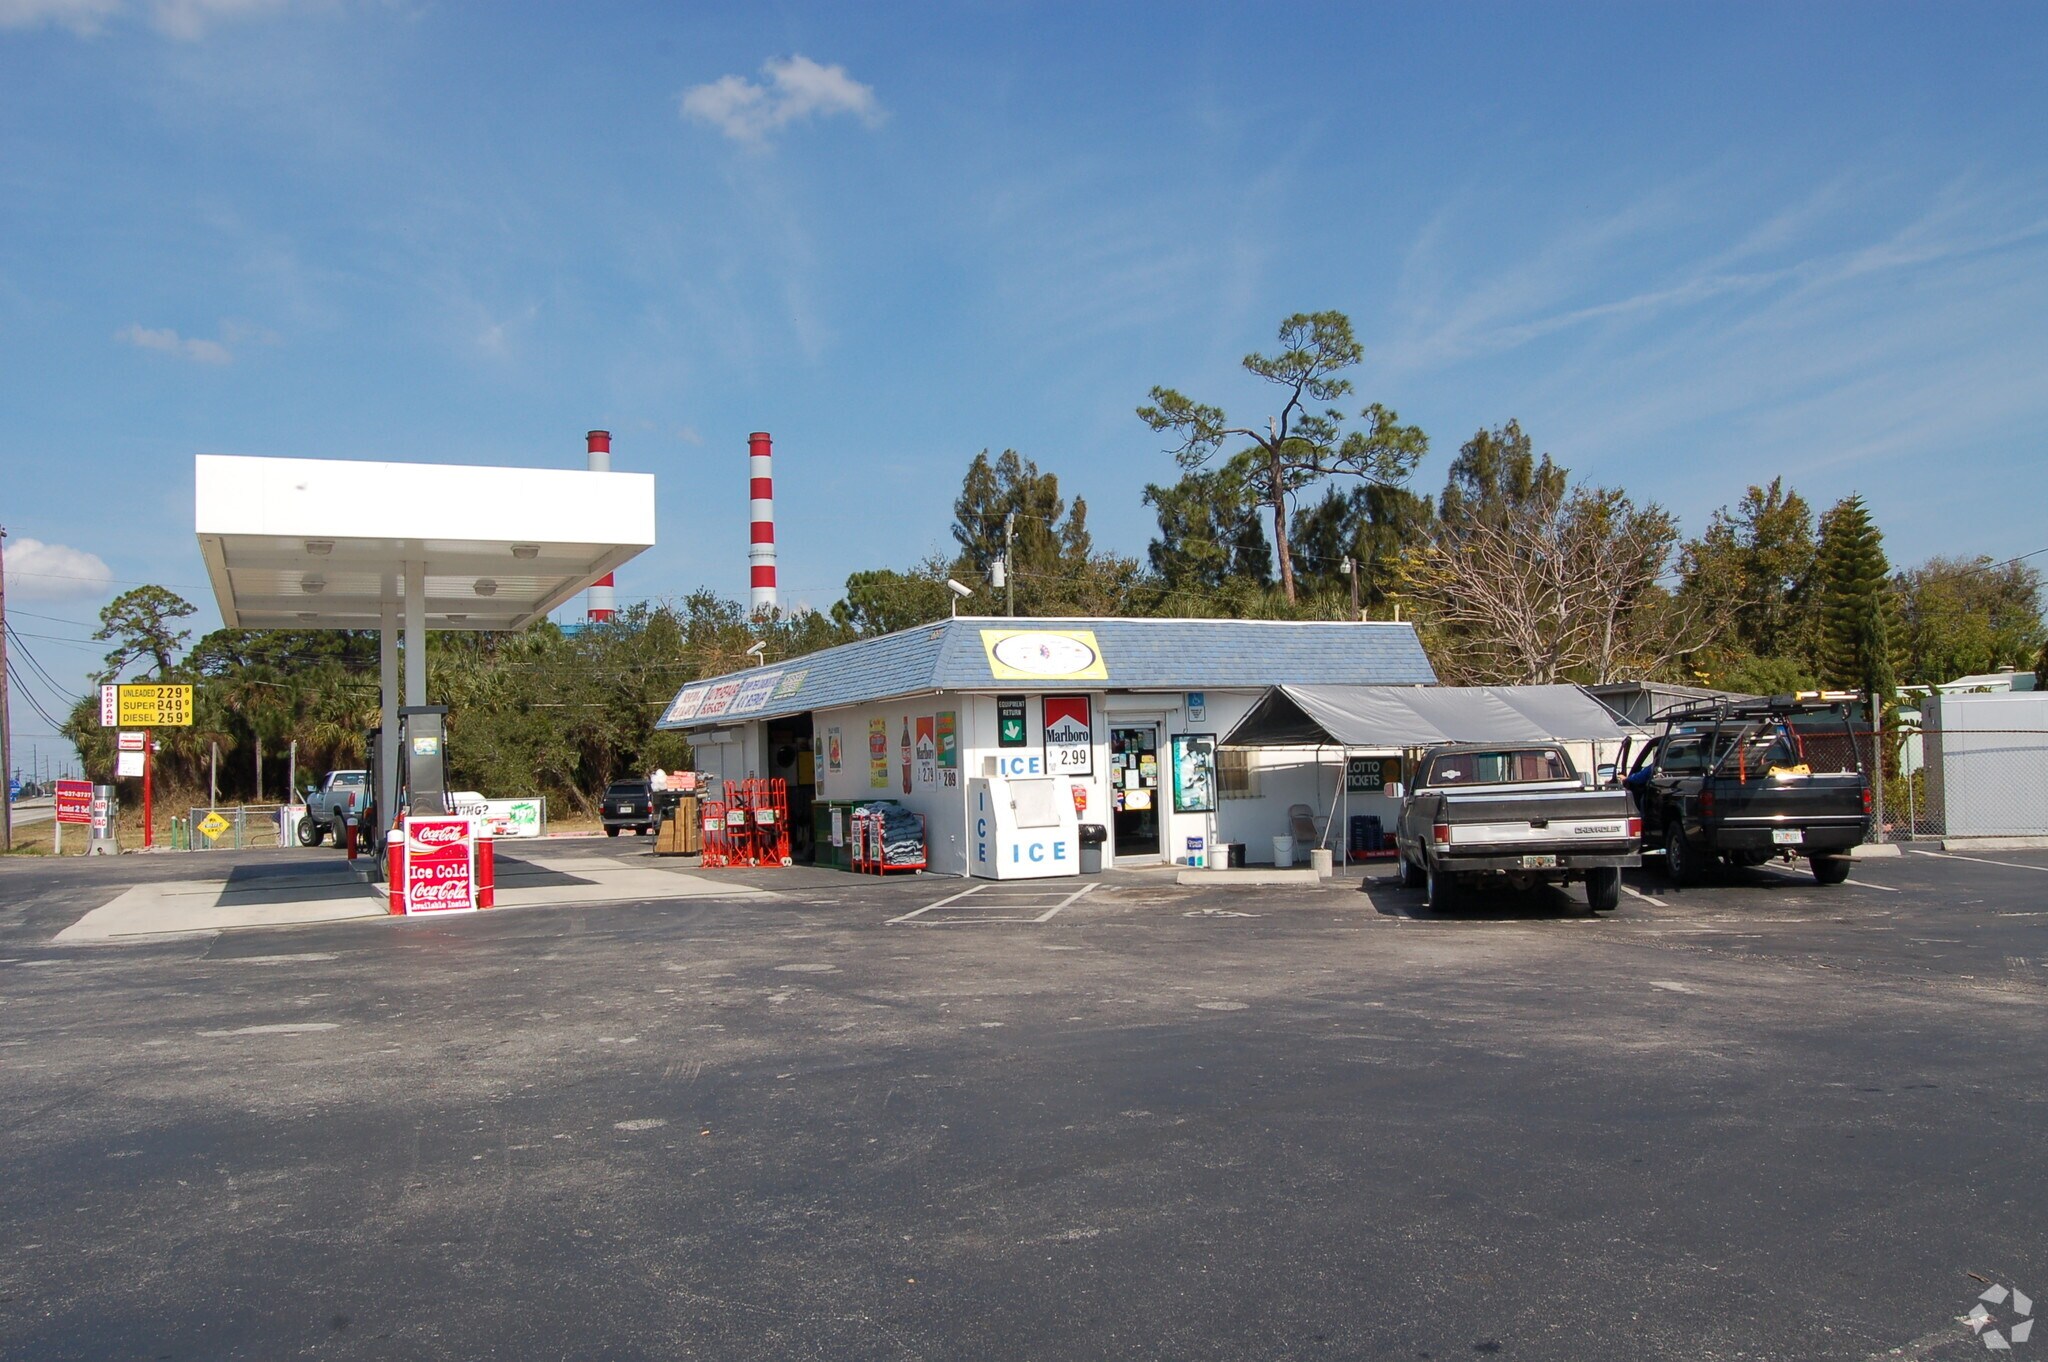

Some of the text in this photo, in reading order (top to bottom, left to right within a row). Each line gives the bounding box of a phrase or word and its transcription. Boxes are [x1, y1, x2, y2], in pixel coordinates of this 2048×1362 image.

[123, 689, 155, 697] UNLEADED
[157, 687, 182, 699] 229
[123, 702, 155, 710] SUPER
[157, 699, 182, 711] 249
[998, 700, 1025, 708] EQUIPMENT
[123, 714, 155, 722] DIESEL
[158, 712, 183, 723] 259
[1046, 724, 1089, 743] Marlboro
[1061, 749, 1087, 765] 2.99
[1000, 757, 1040, 775] ICE
[1348, 761, 1380, 773] LOTTO
[1347, 774, 1380, 786] TICKETS
[95, 802, 106, 810] AIR
[419, 825, 463, 842] Coca-Cola
[977, 792, 986, 863] ICE
[1574, 825, 1622, 834] CHEVROLET
[1013, 841, 1066, 863] ICE
[410, 863, 468, 879] Ice Cold
[411, 880, 468, 901] Coca-Cola
[411, 900, 470, 910] Available Inside
